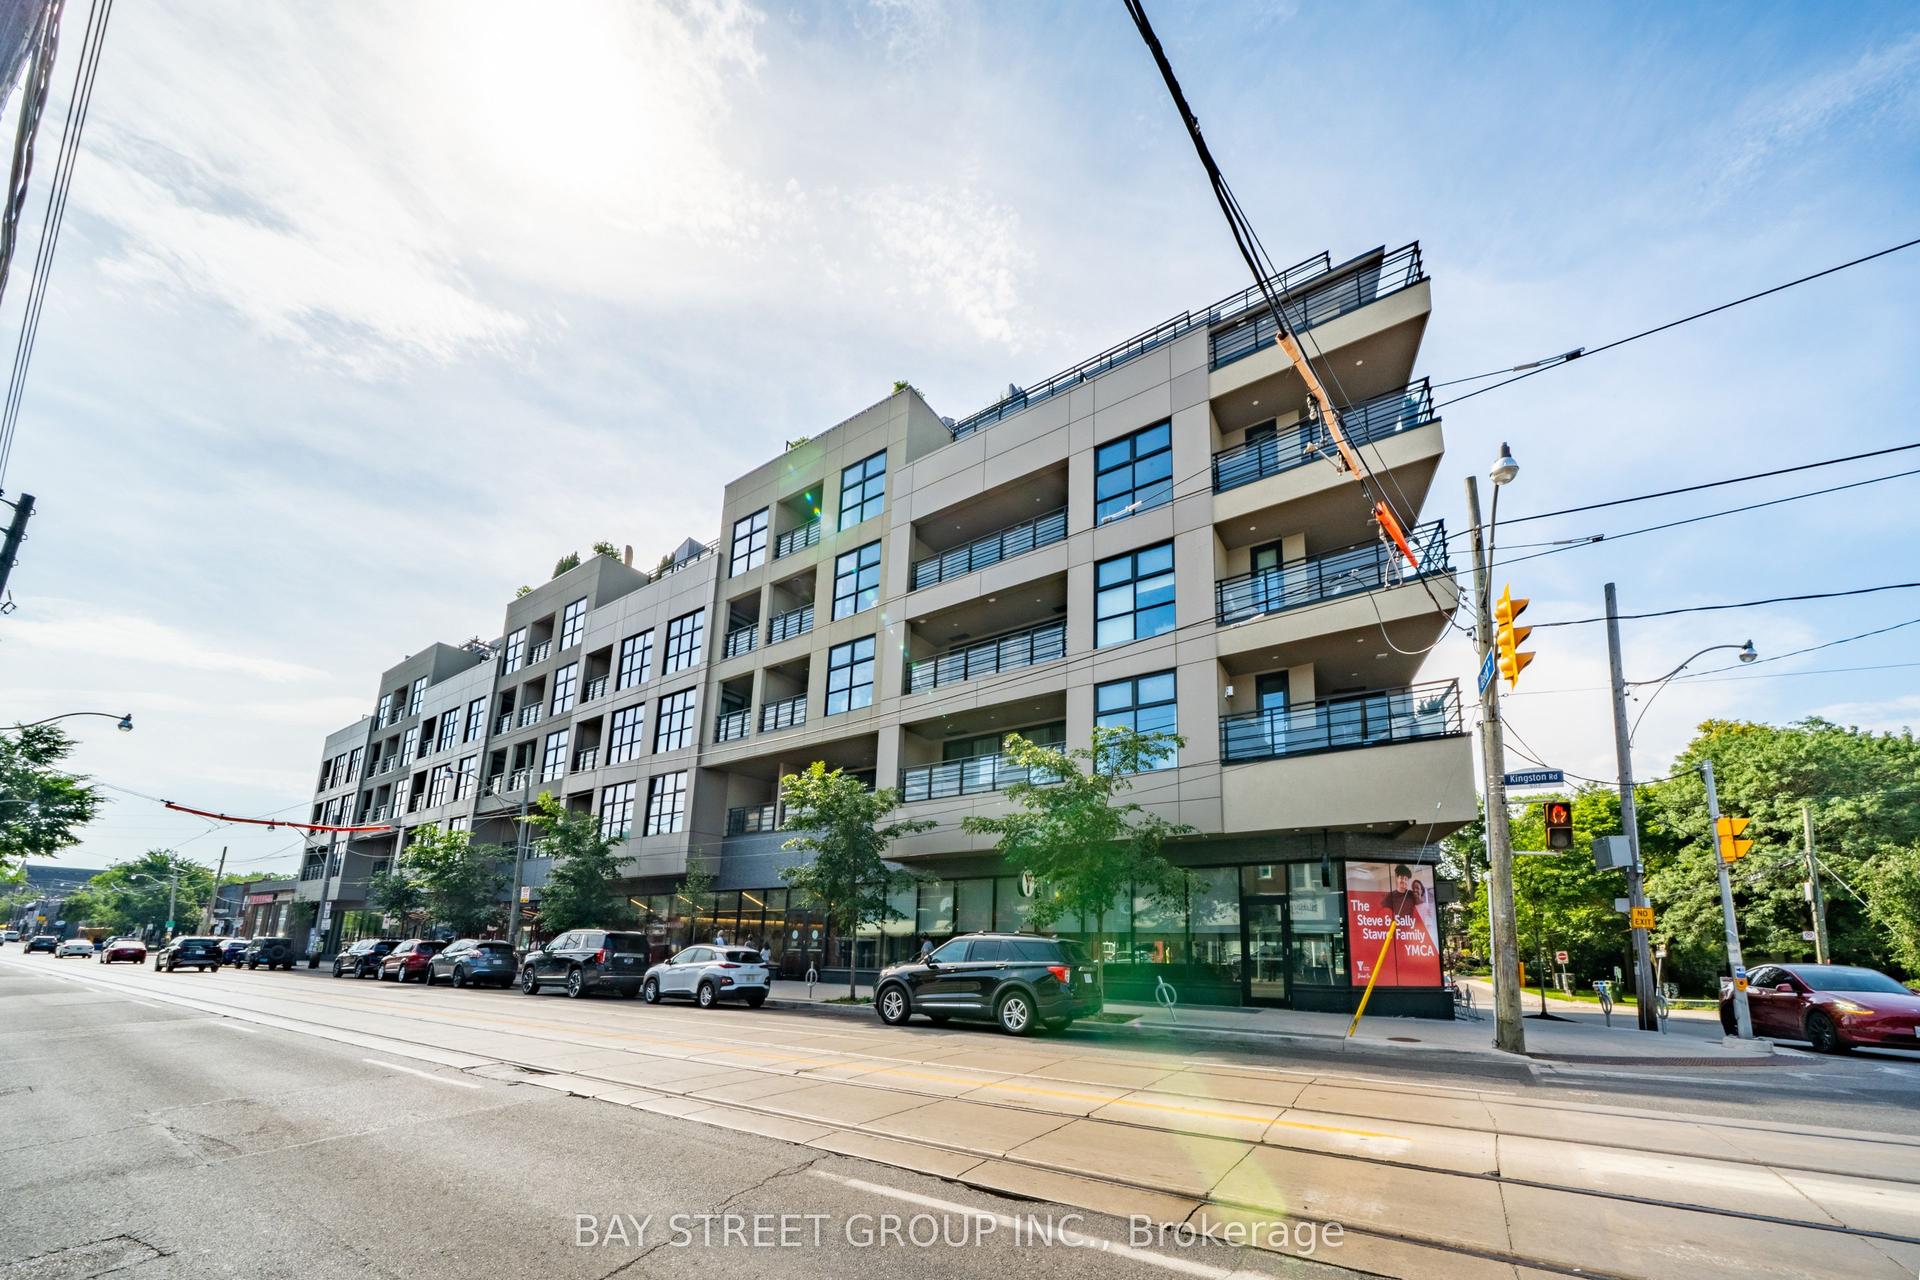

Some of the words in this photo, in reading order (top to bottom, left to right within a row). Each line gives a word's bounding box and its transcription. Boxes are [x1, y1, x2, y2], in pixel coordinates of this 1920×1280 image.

[1510, 773, 1546, 783] Kingston
[1351, 900, 1369, 911] The
[1357, 914, 1382, 926] Steve
[1385, 915, 1391, 926] &
[1395, 914, 1416, 929] Sally
[1635, 918, 1651, 926] EXIT
[1363, 928, 1392, 940] Stavr
[1396, 929, 1425, 943] Family
[1405, 945, 1434, 956] YMCA
